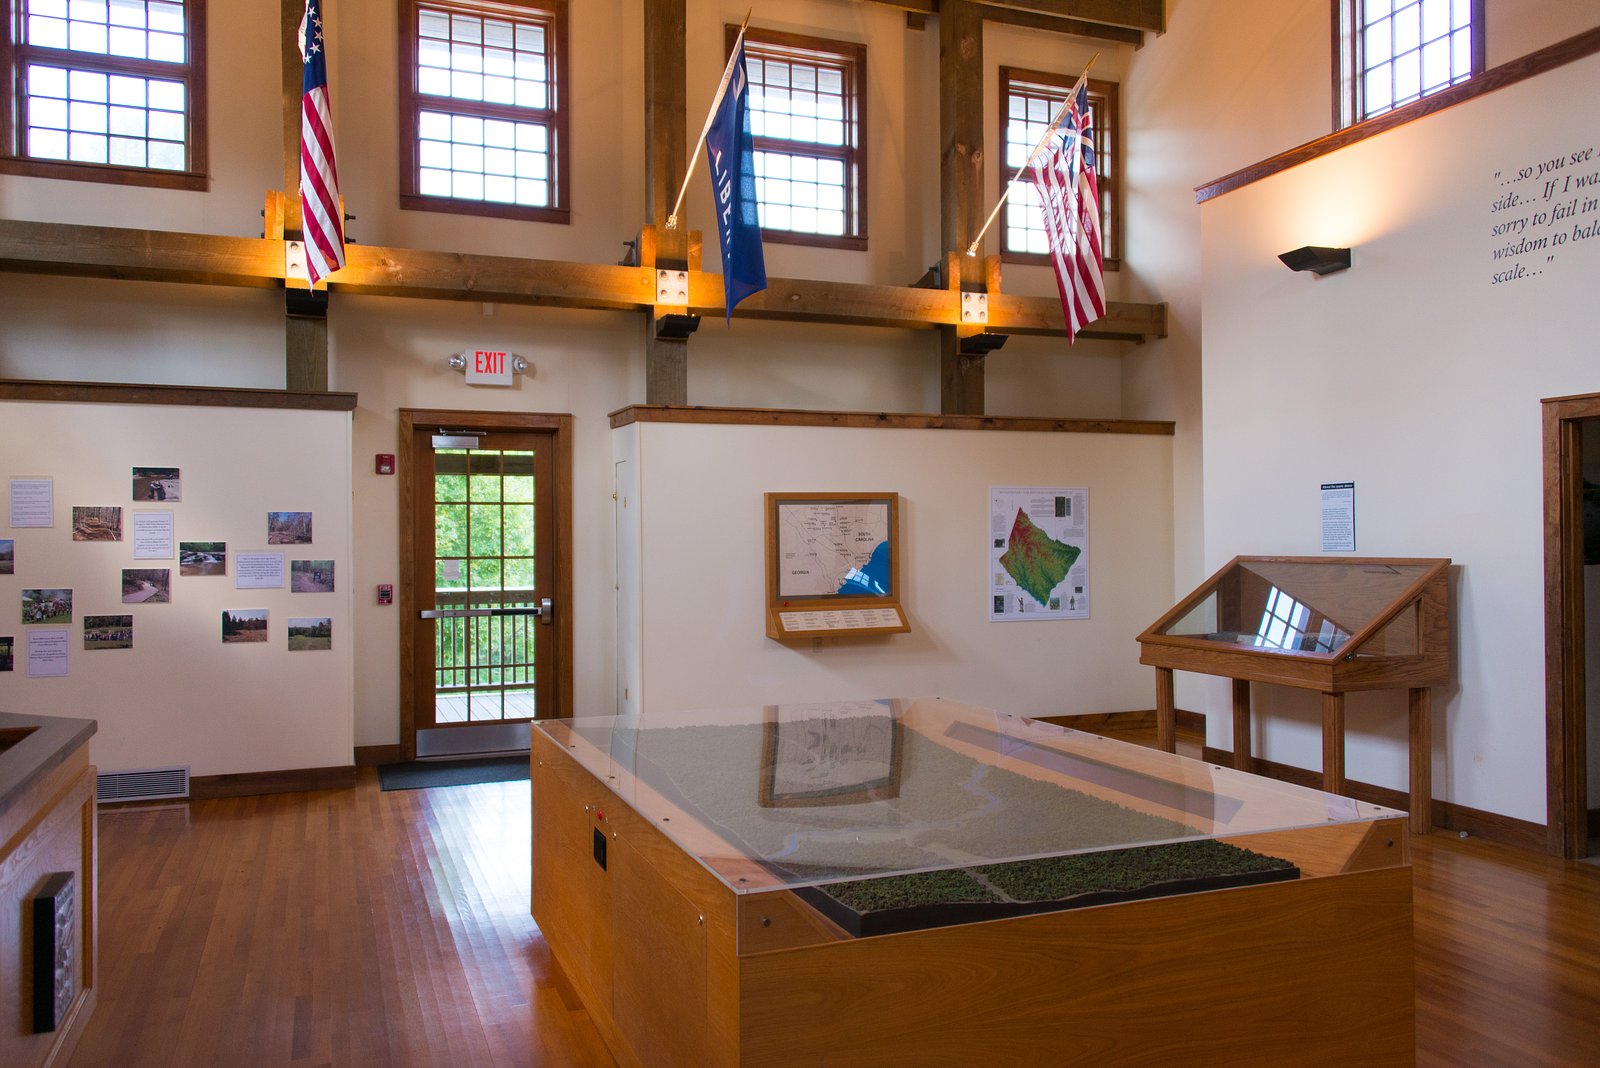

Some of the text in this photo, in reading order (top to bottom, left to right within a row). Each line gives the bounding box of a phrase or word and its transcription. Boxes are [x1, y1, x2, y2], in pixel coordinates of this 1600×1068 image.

[1536, 156, 1565, 180] you
[1570, 148, 1593, 165] see
[1542, 178, 1559, 202] If
[1563, 175, 1572, 193] I
[1576, 171, 1600, 189] wa
[1492, 196, 1599, 237] sorry to fail in
[1493, 237, 1548, 260] wisdom
[1552, 232, 1567, 247] to
[475, 351, 507, 374] EXIT
